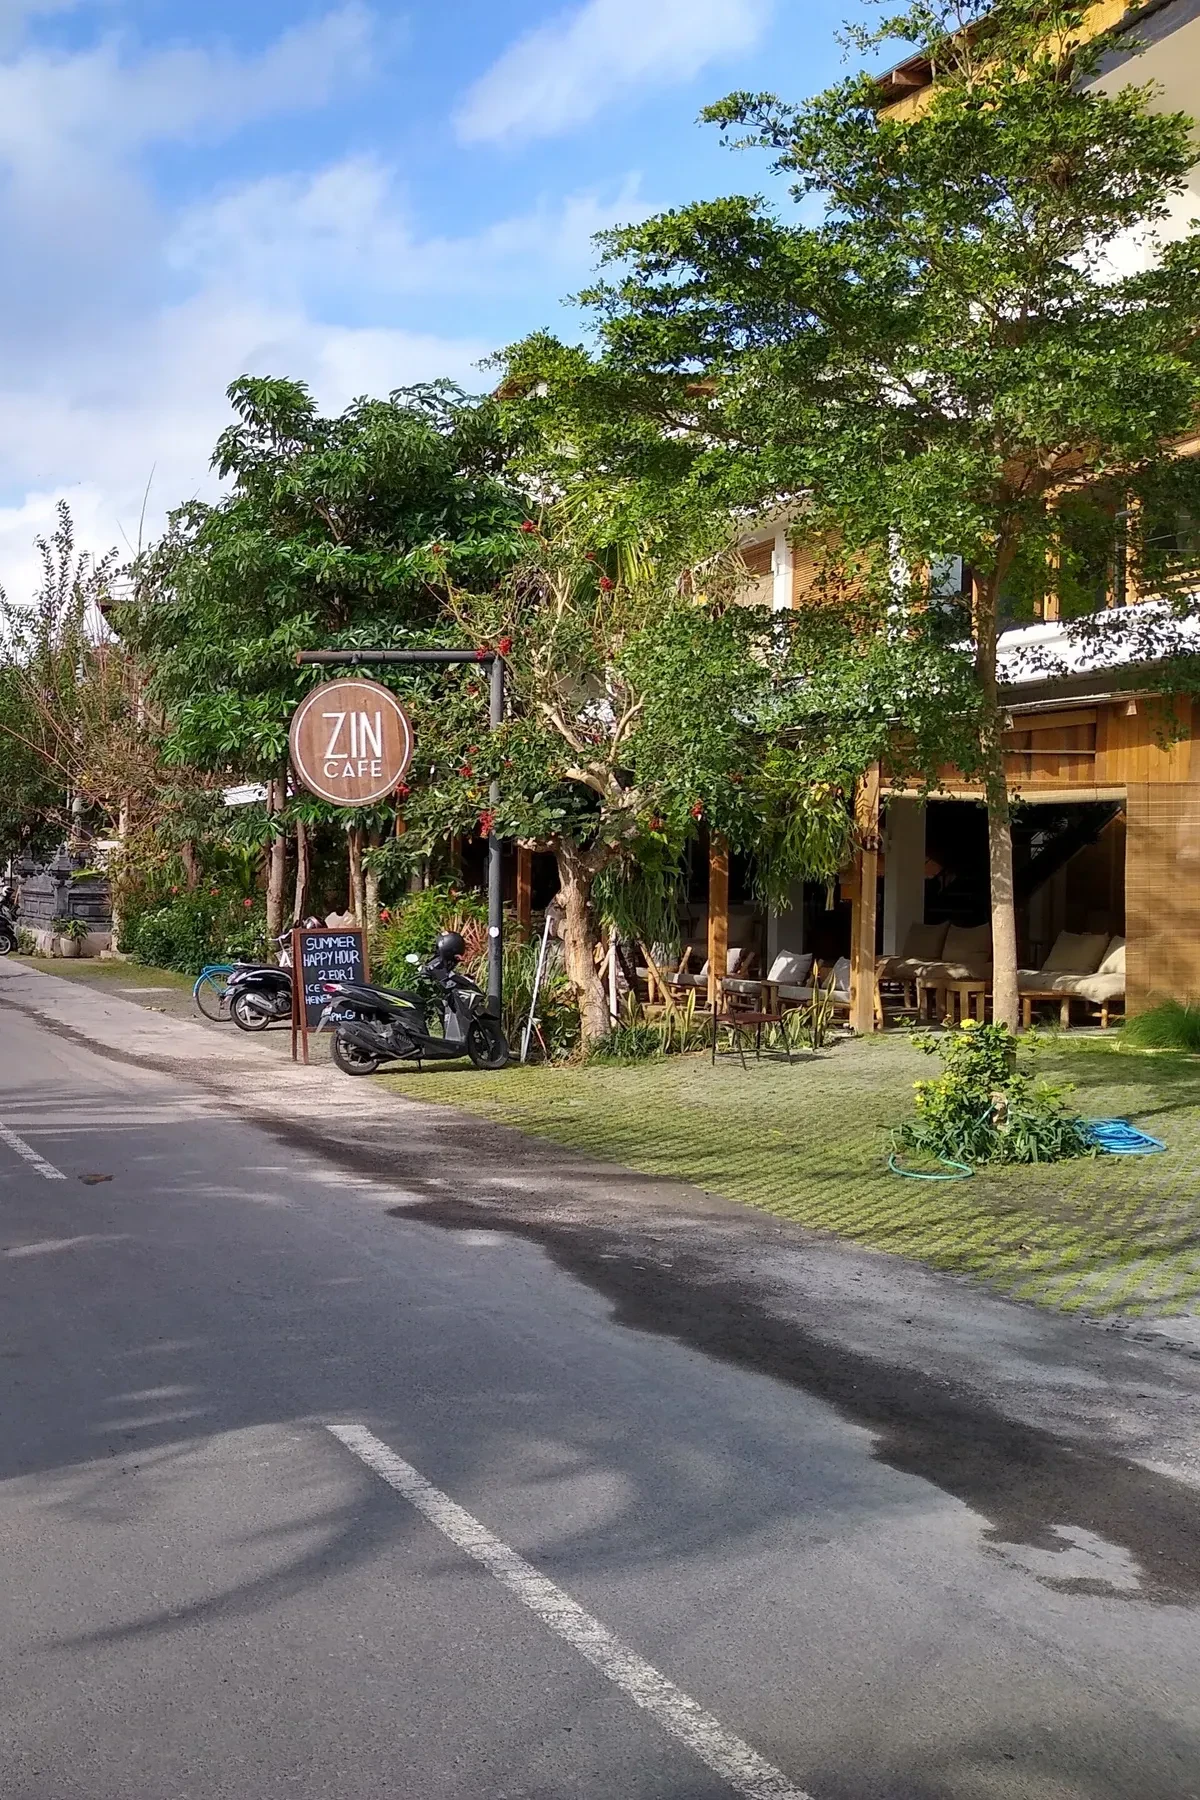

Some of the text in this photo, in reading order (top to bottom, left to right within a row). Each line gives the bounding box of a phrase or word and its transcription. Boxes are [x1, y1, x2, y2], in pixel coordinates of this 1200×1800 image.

[322, 711, 382, 759] ZIN
[323, 760, 382, 778] CAFE
[306, 936, 356, 951] SUMMER
[303, 950, 360, 967] HAPPY HOUR
[318, 967, 354, 980] 2 FOR 1
[305, 984, 320, 994] ICE
